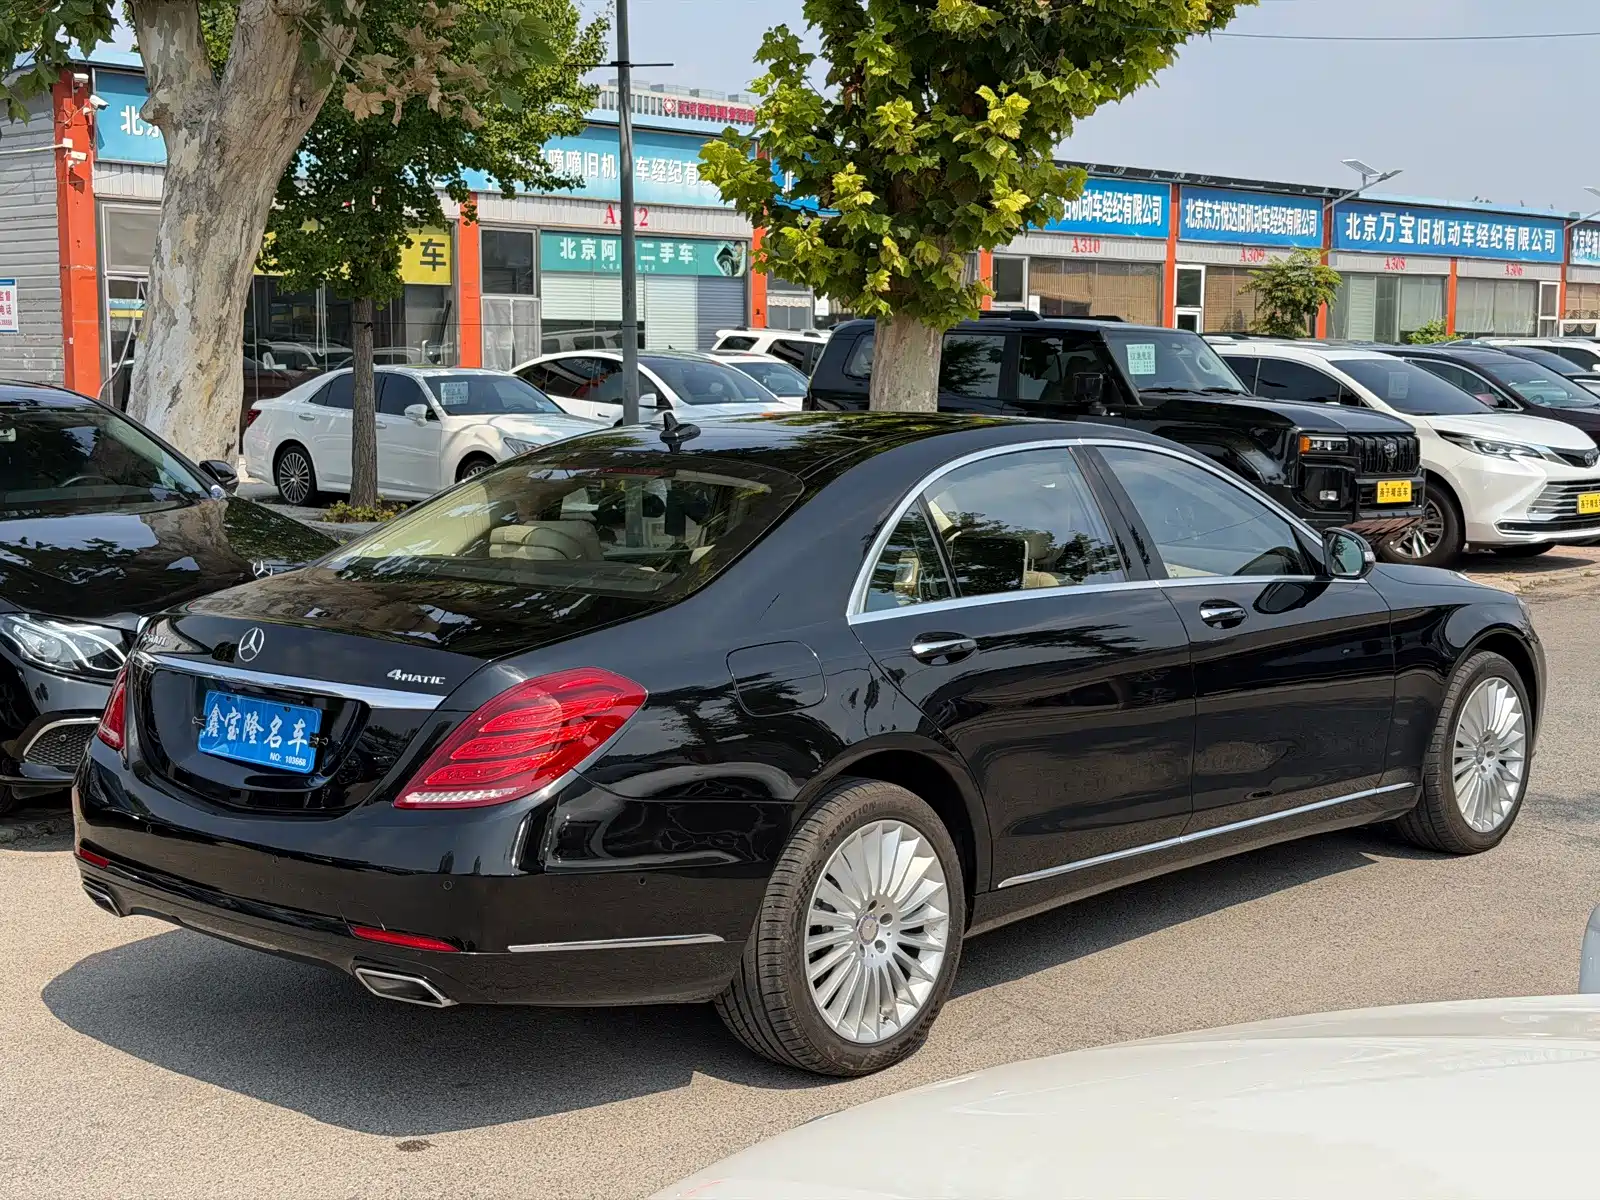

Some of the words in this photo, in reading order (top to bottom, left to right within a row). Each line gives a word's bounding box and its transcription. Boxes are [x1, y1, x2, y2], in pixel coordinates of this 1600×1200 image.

[603, 203, 649, 227] A2
[1071, 236, 1101, 253] A310
[1345, 212, 1557, 254] 北京万宝旧机动车经纪有限公司
[419, 238, 447, 272] 车
[559, 237, 694, 264] 北京阿二手车
[386, 668, 446, 685] 4MATIC
[206, 702, 308, 756] 鑫宝隆名车
